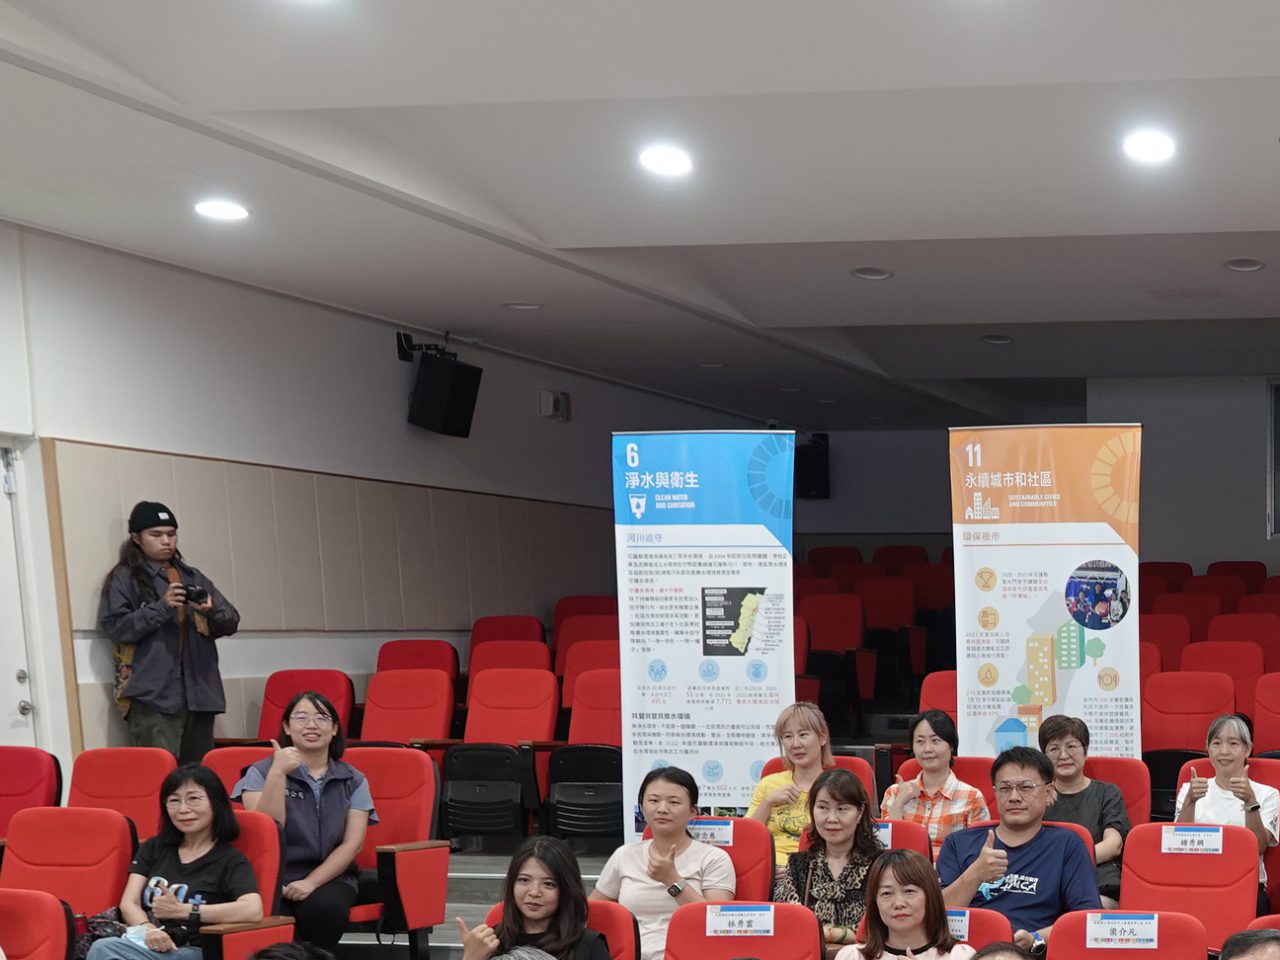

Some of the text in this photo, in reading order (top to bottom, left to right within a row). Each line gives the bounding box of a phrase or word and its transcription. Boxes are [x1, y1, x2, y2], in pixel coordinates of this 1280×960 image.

[626, 443, 639, 467] 6
[965, 443, 982, 467] 11
[625, 471, 699, 488] 淨水與衛生
[965, 471, 1052, 488] 永續城市和社區
